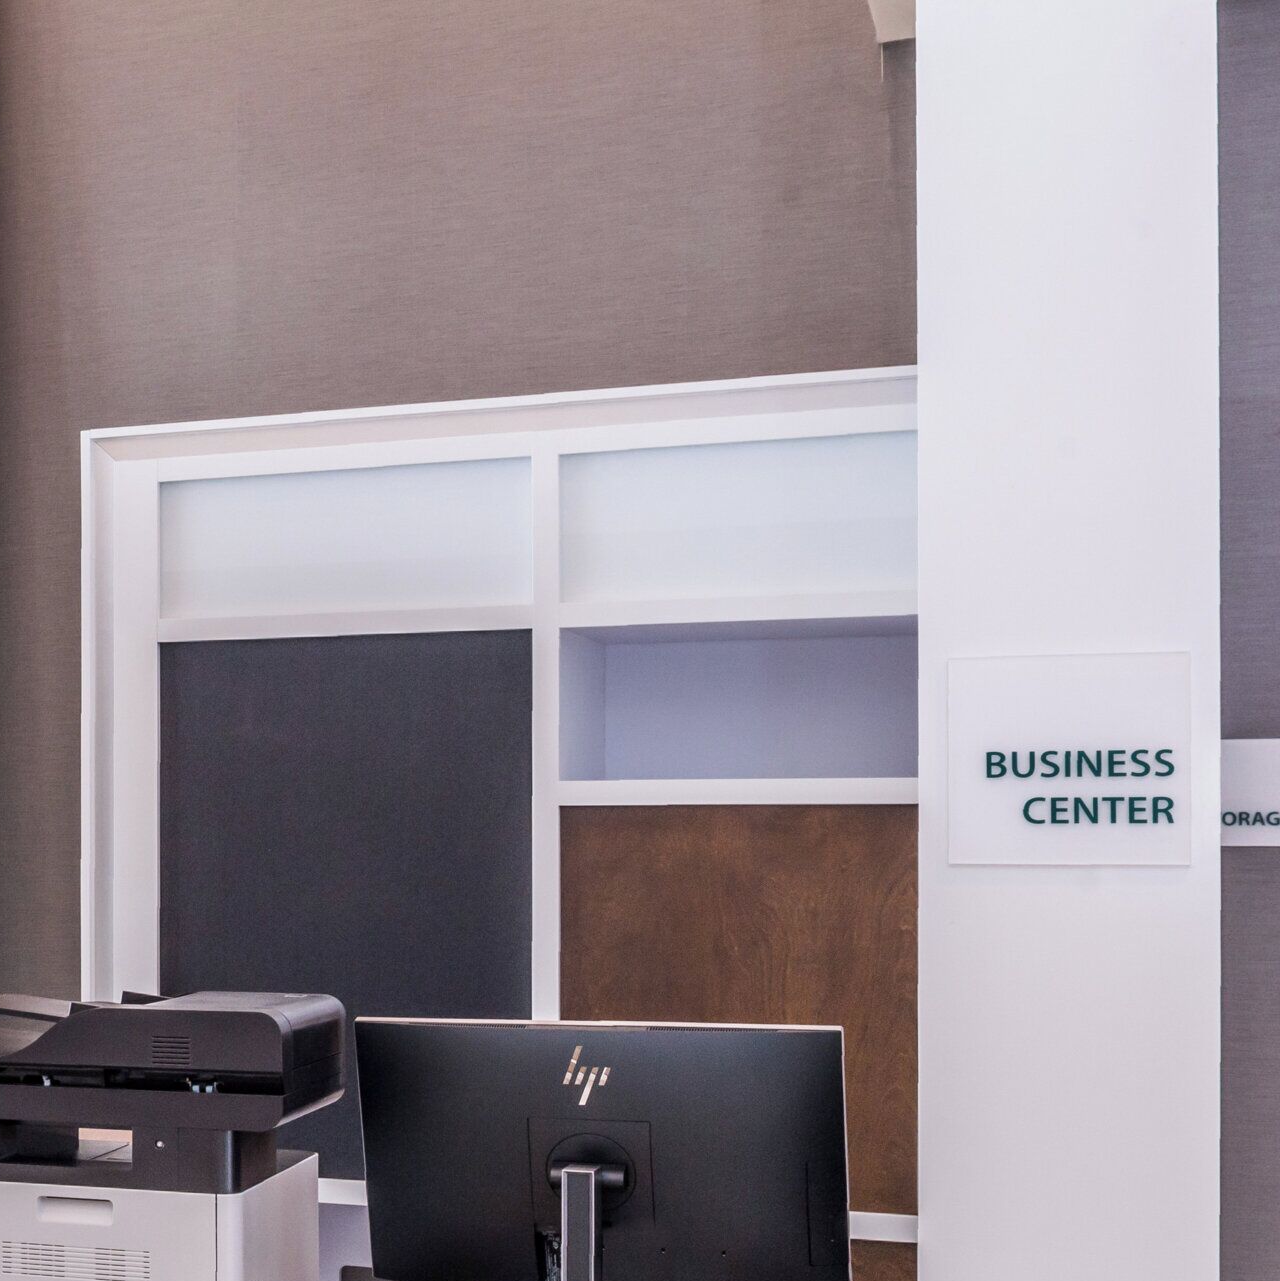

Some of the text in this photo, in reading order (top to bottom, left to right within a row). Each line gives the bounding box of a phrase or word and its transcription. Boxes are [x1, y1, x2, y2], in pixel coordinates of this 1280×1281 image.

[985, 749, 1175, 778] BUSINESS
[1022, 796, 1175, 824] CENTER
[562, 1045, 611, 1106] hp
